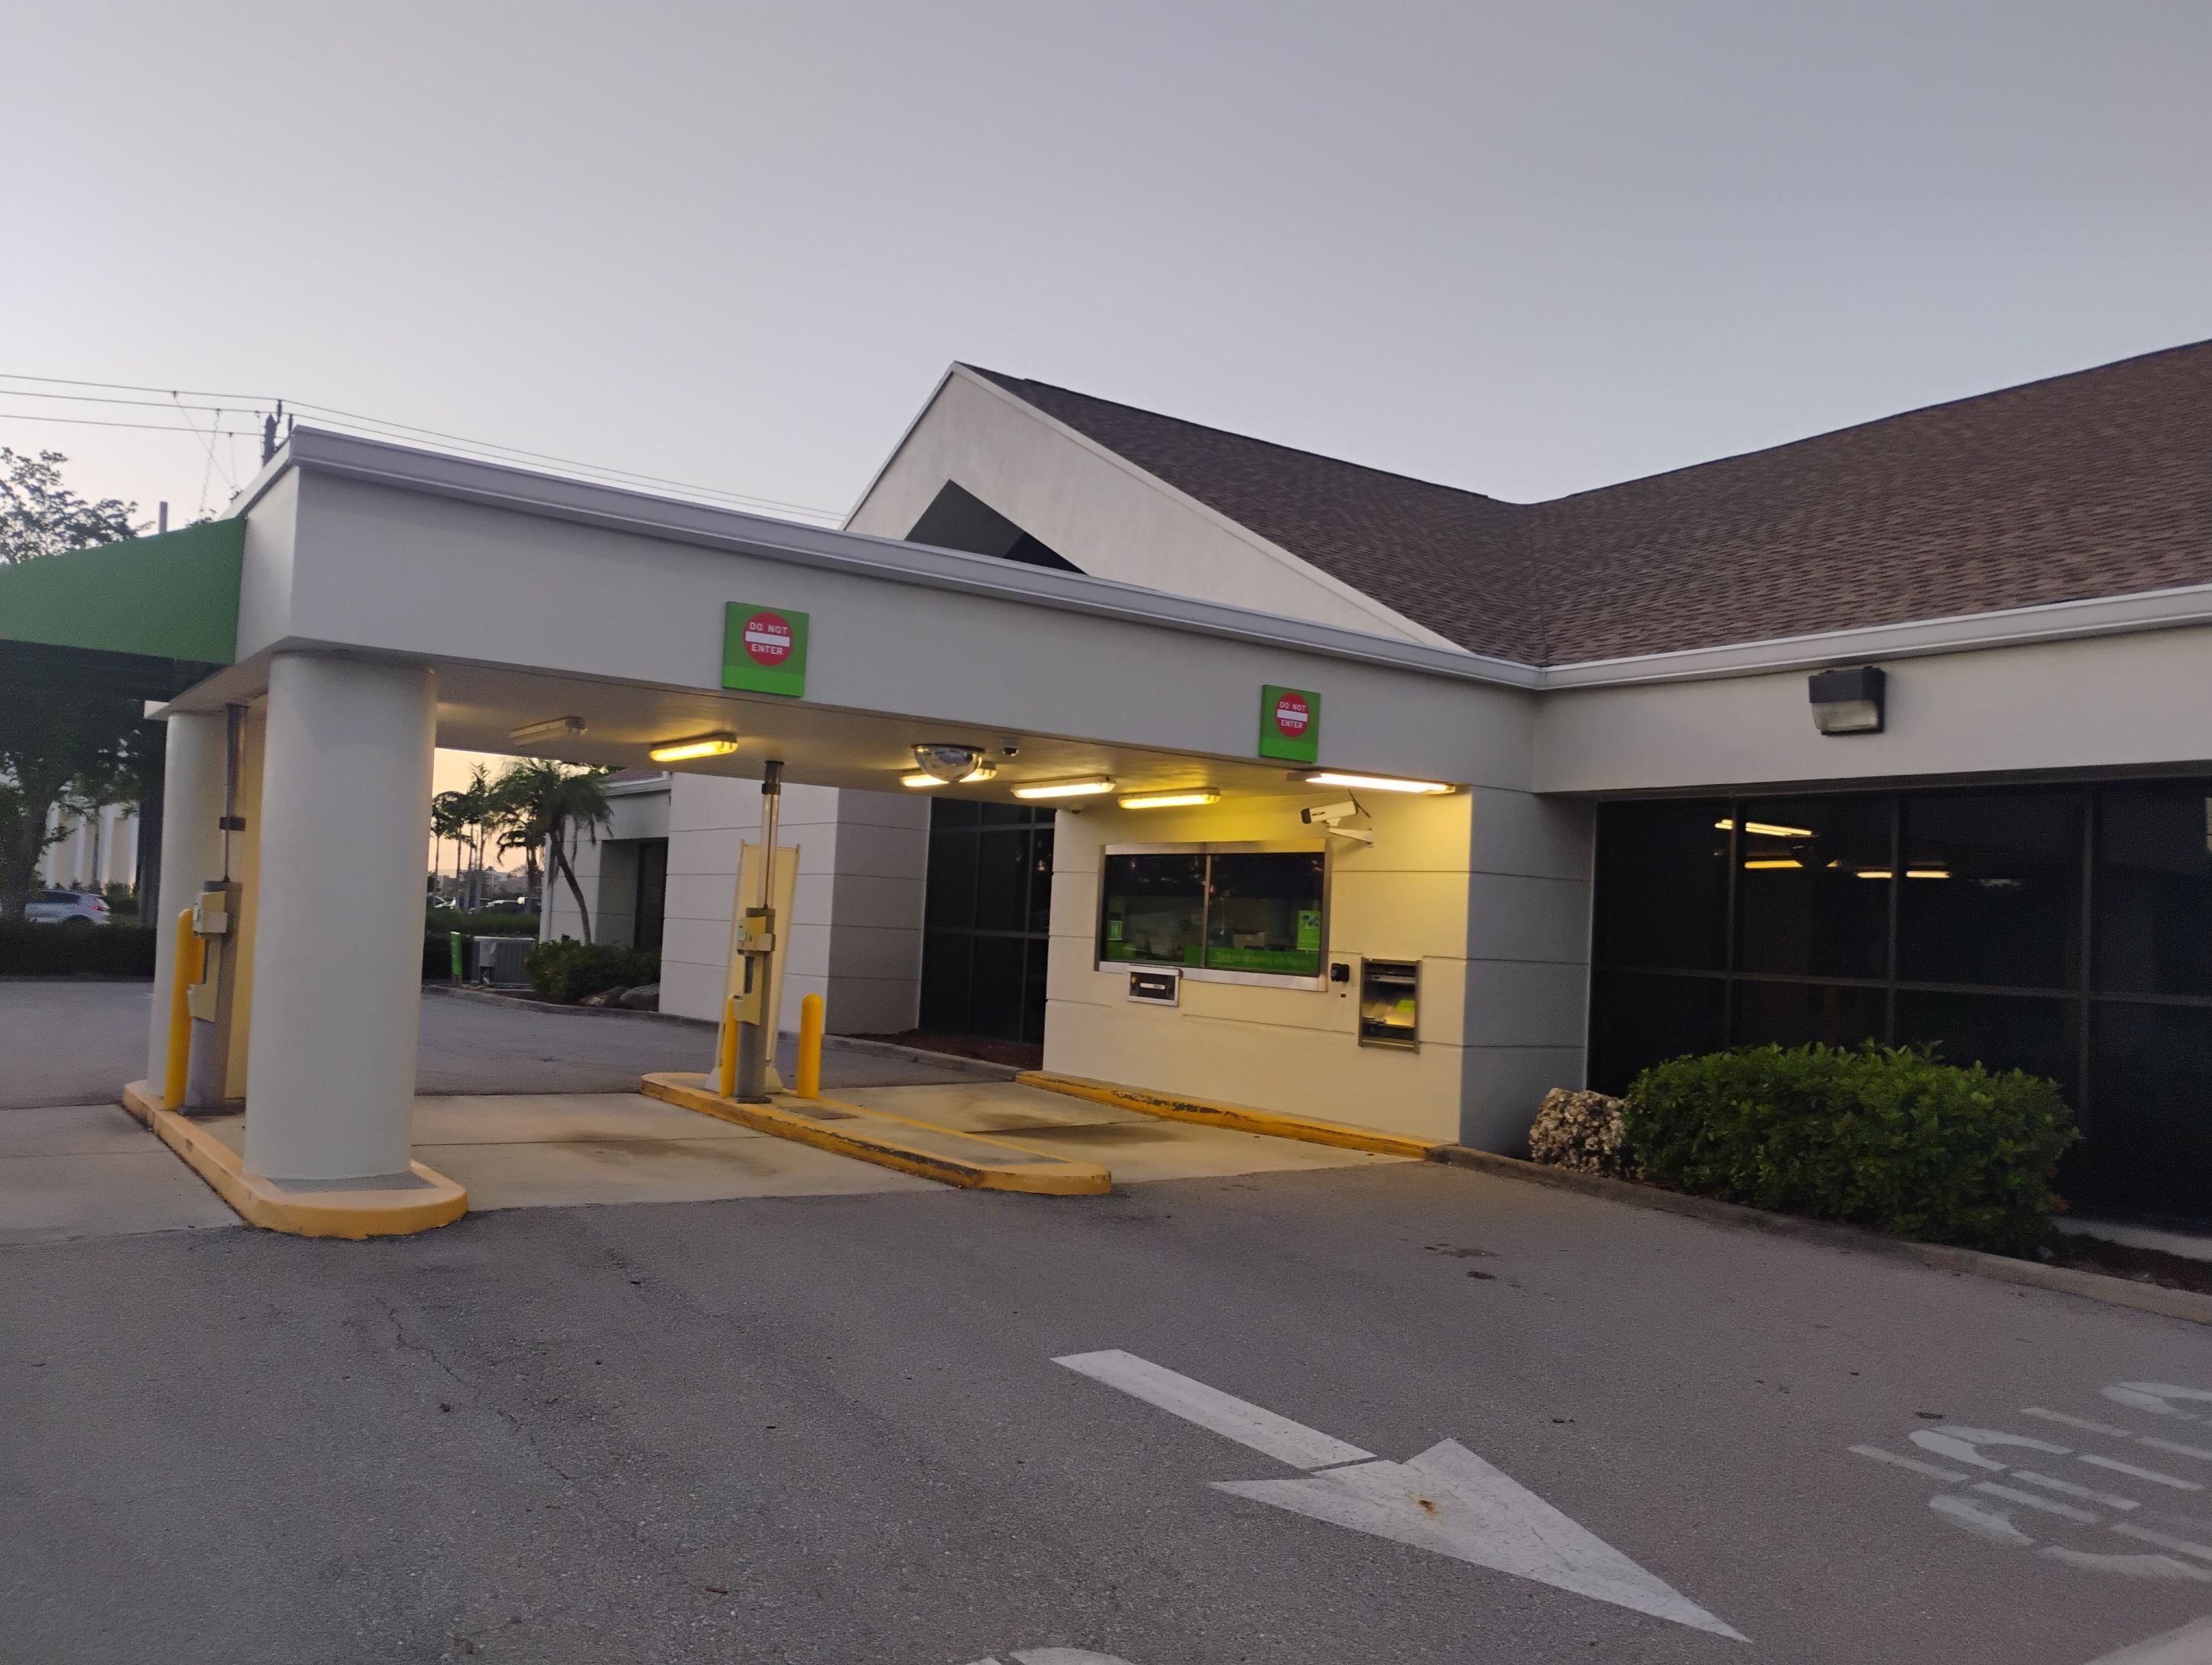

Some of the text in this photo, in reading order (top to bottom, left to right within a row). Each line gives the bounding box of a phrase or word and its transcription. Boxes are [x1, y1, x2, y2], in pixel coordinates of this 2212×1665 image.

[749, 621, 789, 635] DO NOT
[751, 644, 783, 655] ENTER
[1280, 701, 1307, 712] DO NOT
[1280, 719, 1303, 729] ENTER
